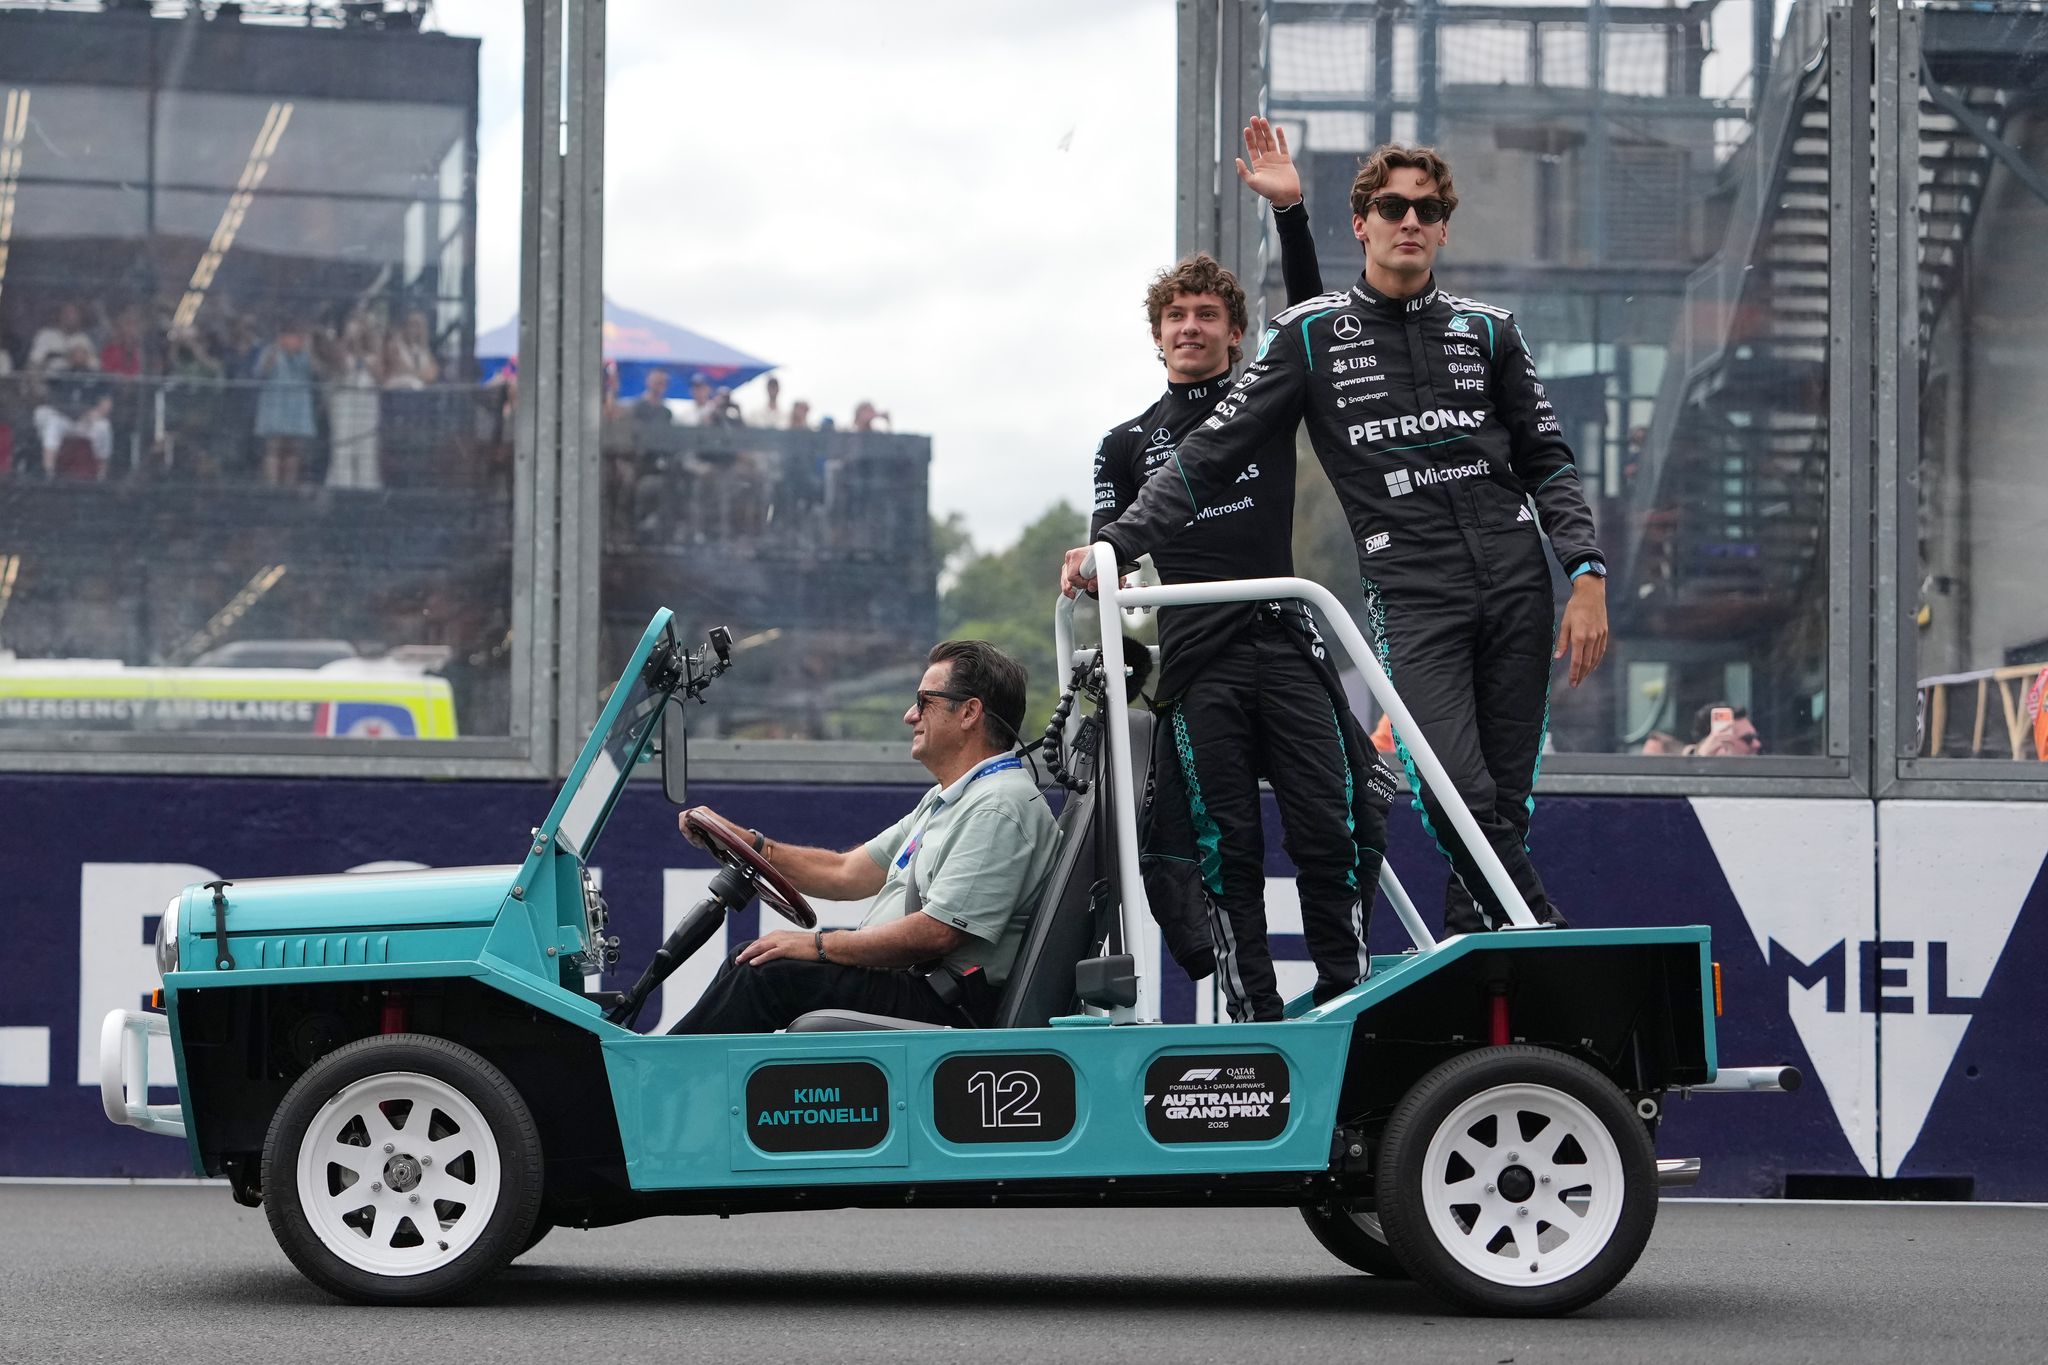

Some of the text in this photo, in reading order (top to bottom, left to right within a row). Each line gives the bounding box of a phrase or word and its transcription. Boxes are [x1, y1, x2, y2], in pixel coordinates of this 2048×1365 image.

[1444, 331, 1479, 340] PETRONAS
[1348, 355, 1378, 370] UBS
[1335, 374, 1386, 388] CROWDSTRIKE
[1454, 379, 1485, 391] HPE
[1348, 391, 1389, 404] Snapdragon
[1347, 408, 1486, 446] PETRONAS
[1414, 459, 1491, 487] Microsoft
[1196, 496, 1255, 520] Microsoft
[1365, 534, 1390, 551] OMP
[0, 699, 314, 722] MERGENCY AMBULANCE
[1768, 936, 1982, 1015] MEL
[1226, 1067, 1256, 1078] QATAR
[1212, 1083, 1235, 1091] QATAR
[1236, 1082, 1266, 1090] AIRWAYS
[794, 1088, 840, 1104] KIMI
[967, 1071, 1041, 1128] 12
[1161, 1091, 1275, 1107] AUSTRALIAN
[757, 1106, 879, 1126] ANTONELLI
[1165, 1104, 1271, 1120] GRAND PRIX
[1207, 1121, 1230, 1130] 2026
